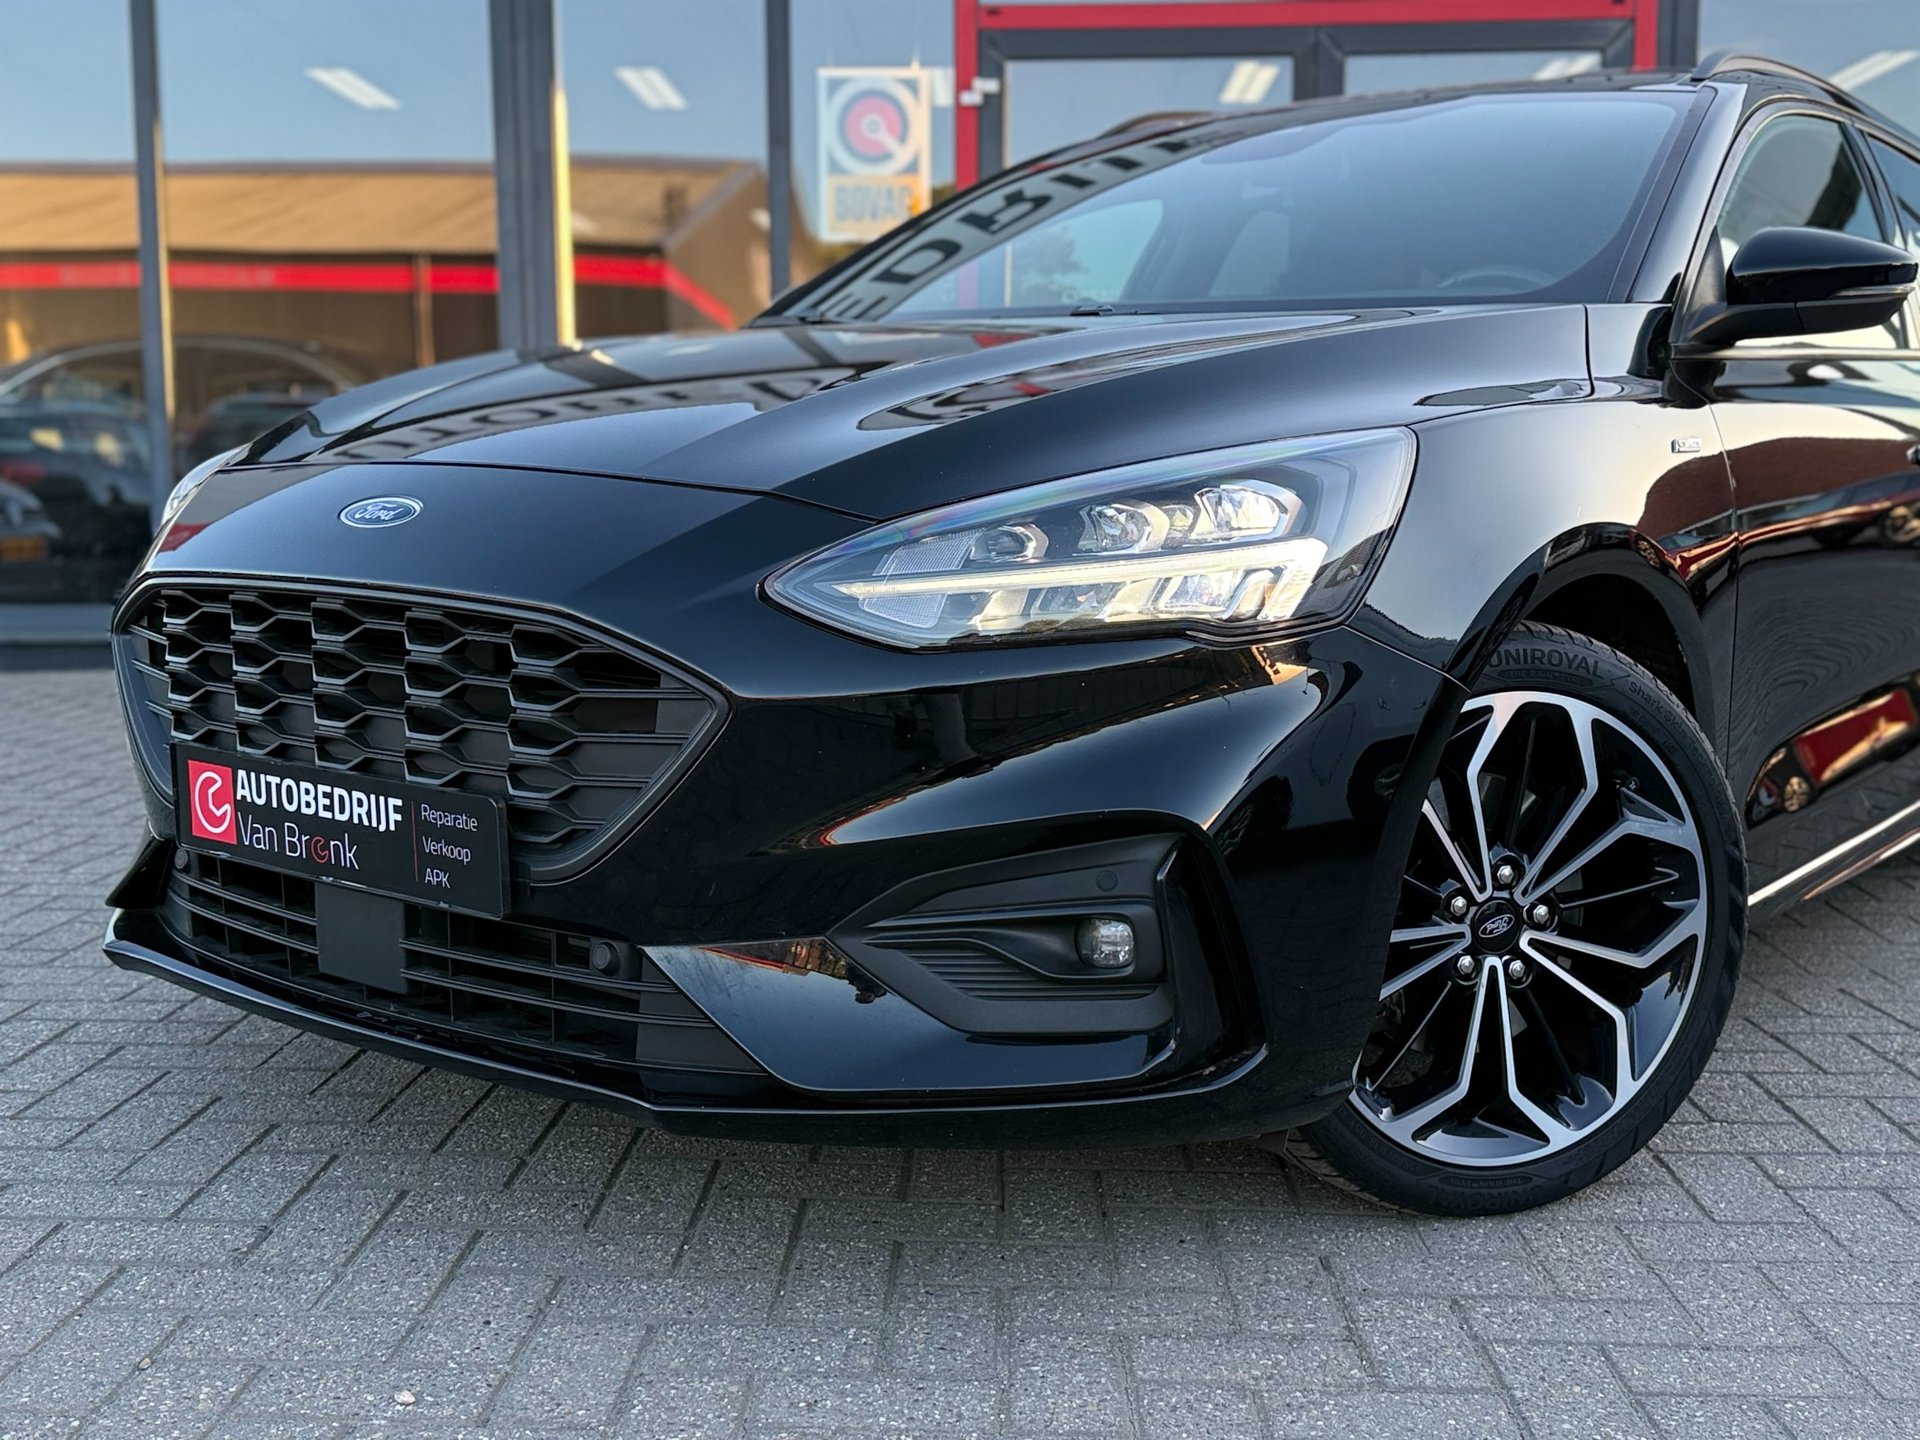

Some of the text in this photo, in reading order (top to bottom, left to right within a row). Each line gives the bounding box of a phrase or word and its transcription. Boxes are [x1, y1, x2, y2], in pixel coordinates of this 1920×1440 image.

[354, 502, 403, 520] Ford
[1488, 647, 1605, 680] UNIROYAL
[236, 769, 403, 832] AUTOBEDRIJF
[237, 811, 279, 852] Van
[421, 803, 478, 832] Reparatie
[422, 835, 471, 866] Verkoop
[425, 868, 451, 889] APK
[1486, 916, 1509, 934] Ford
